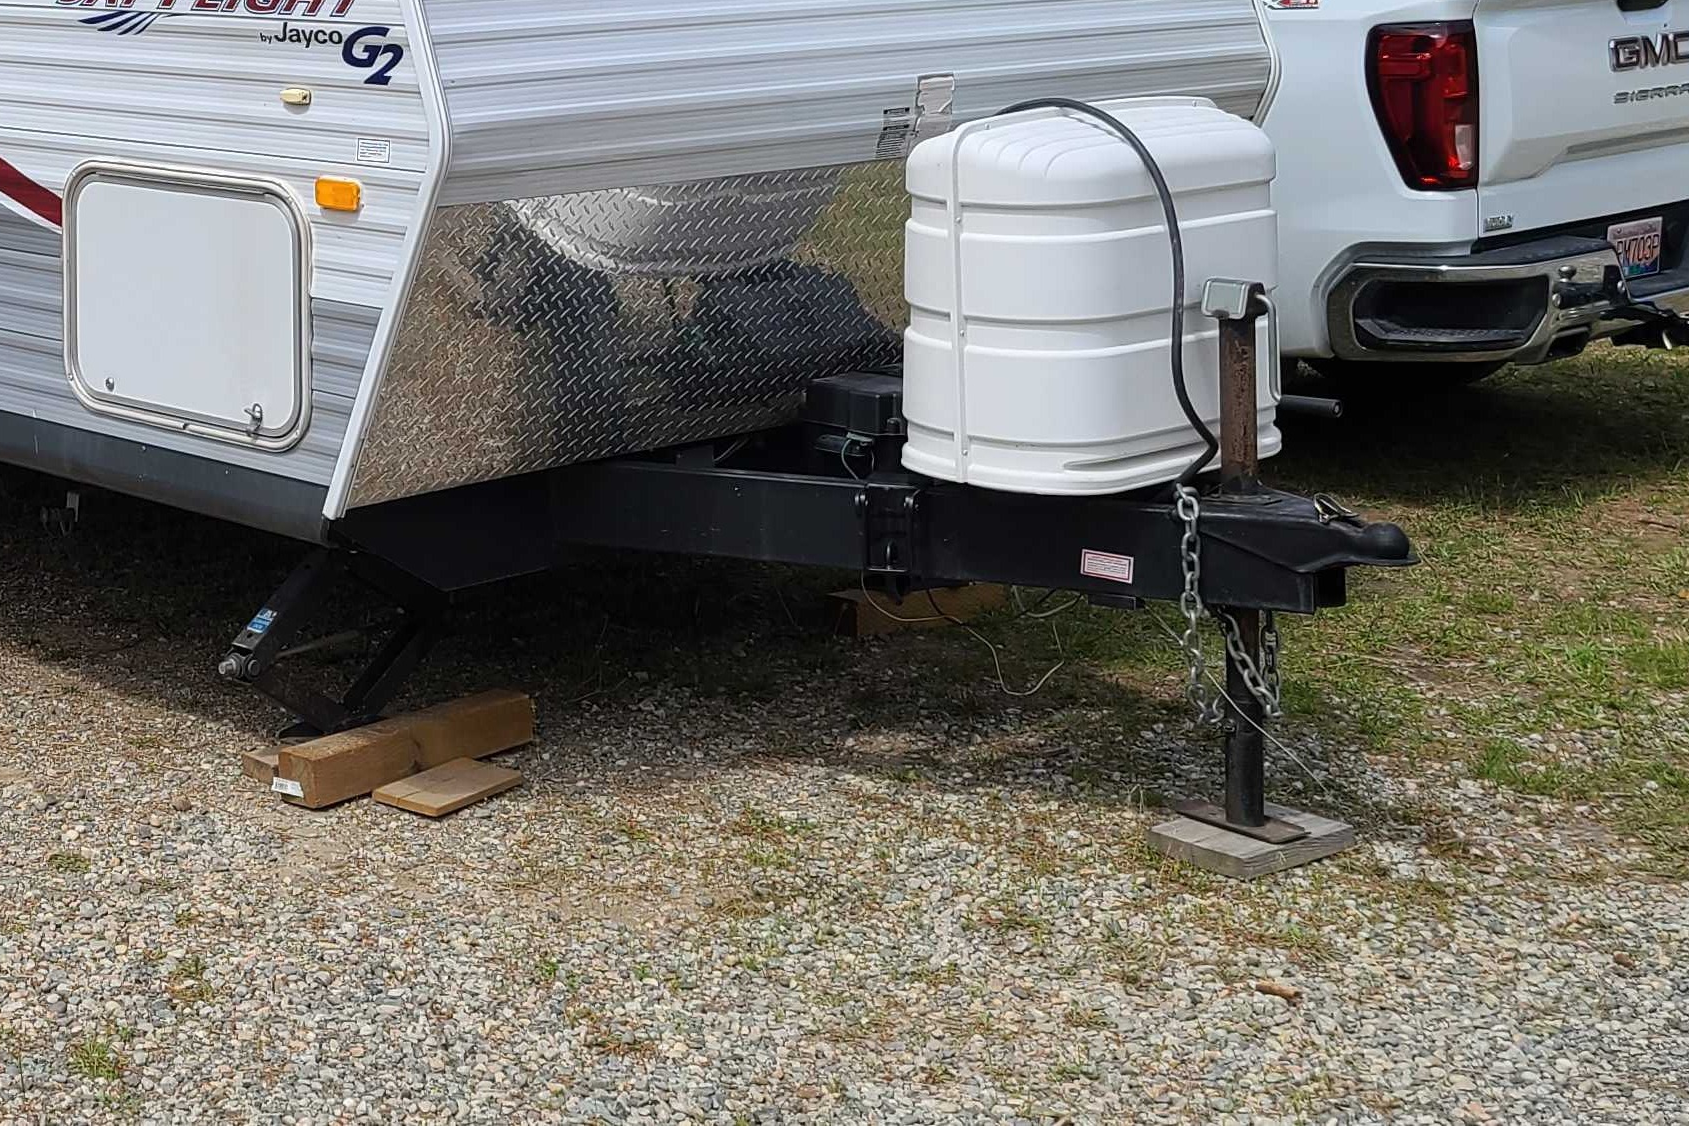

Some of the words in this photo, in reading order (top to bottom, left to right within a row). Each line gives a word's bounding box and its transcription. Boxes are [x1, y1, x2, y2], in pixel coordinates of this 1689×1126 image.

[260, 32, 273, 45] by
[274, 22, 343, 49] Jayco
[341, 27, 404, 85] G2
[1608, 30, 1689, 72] GMC
